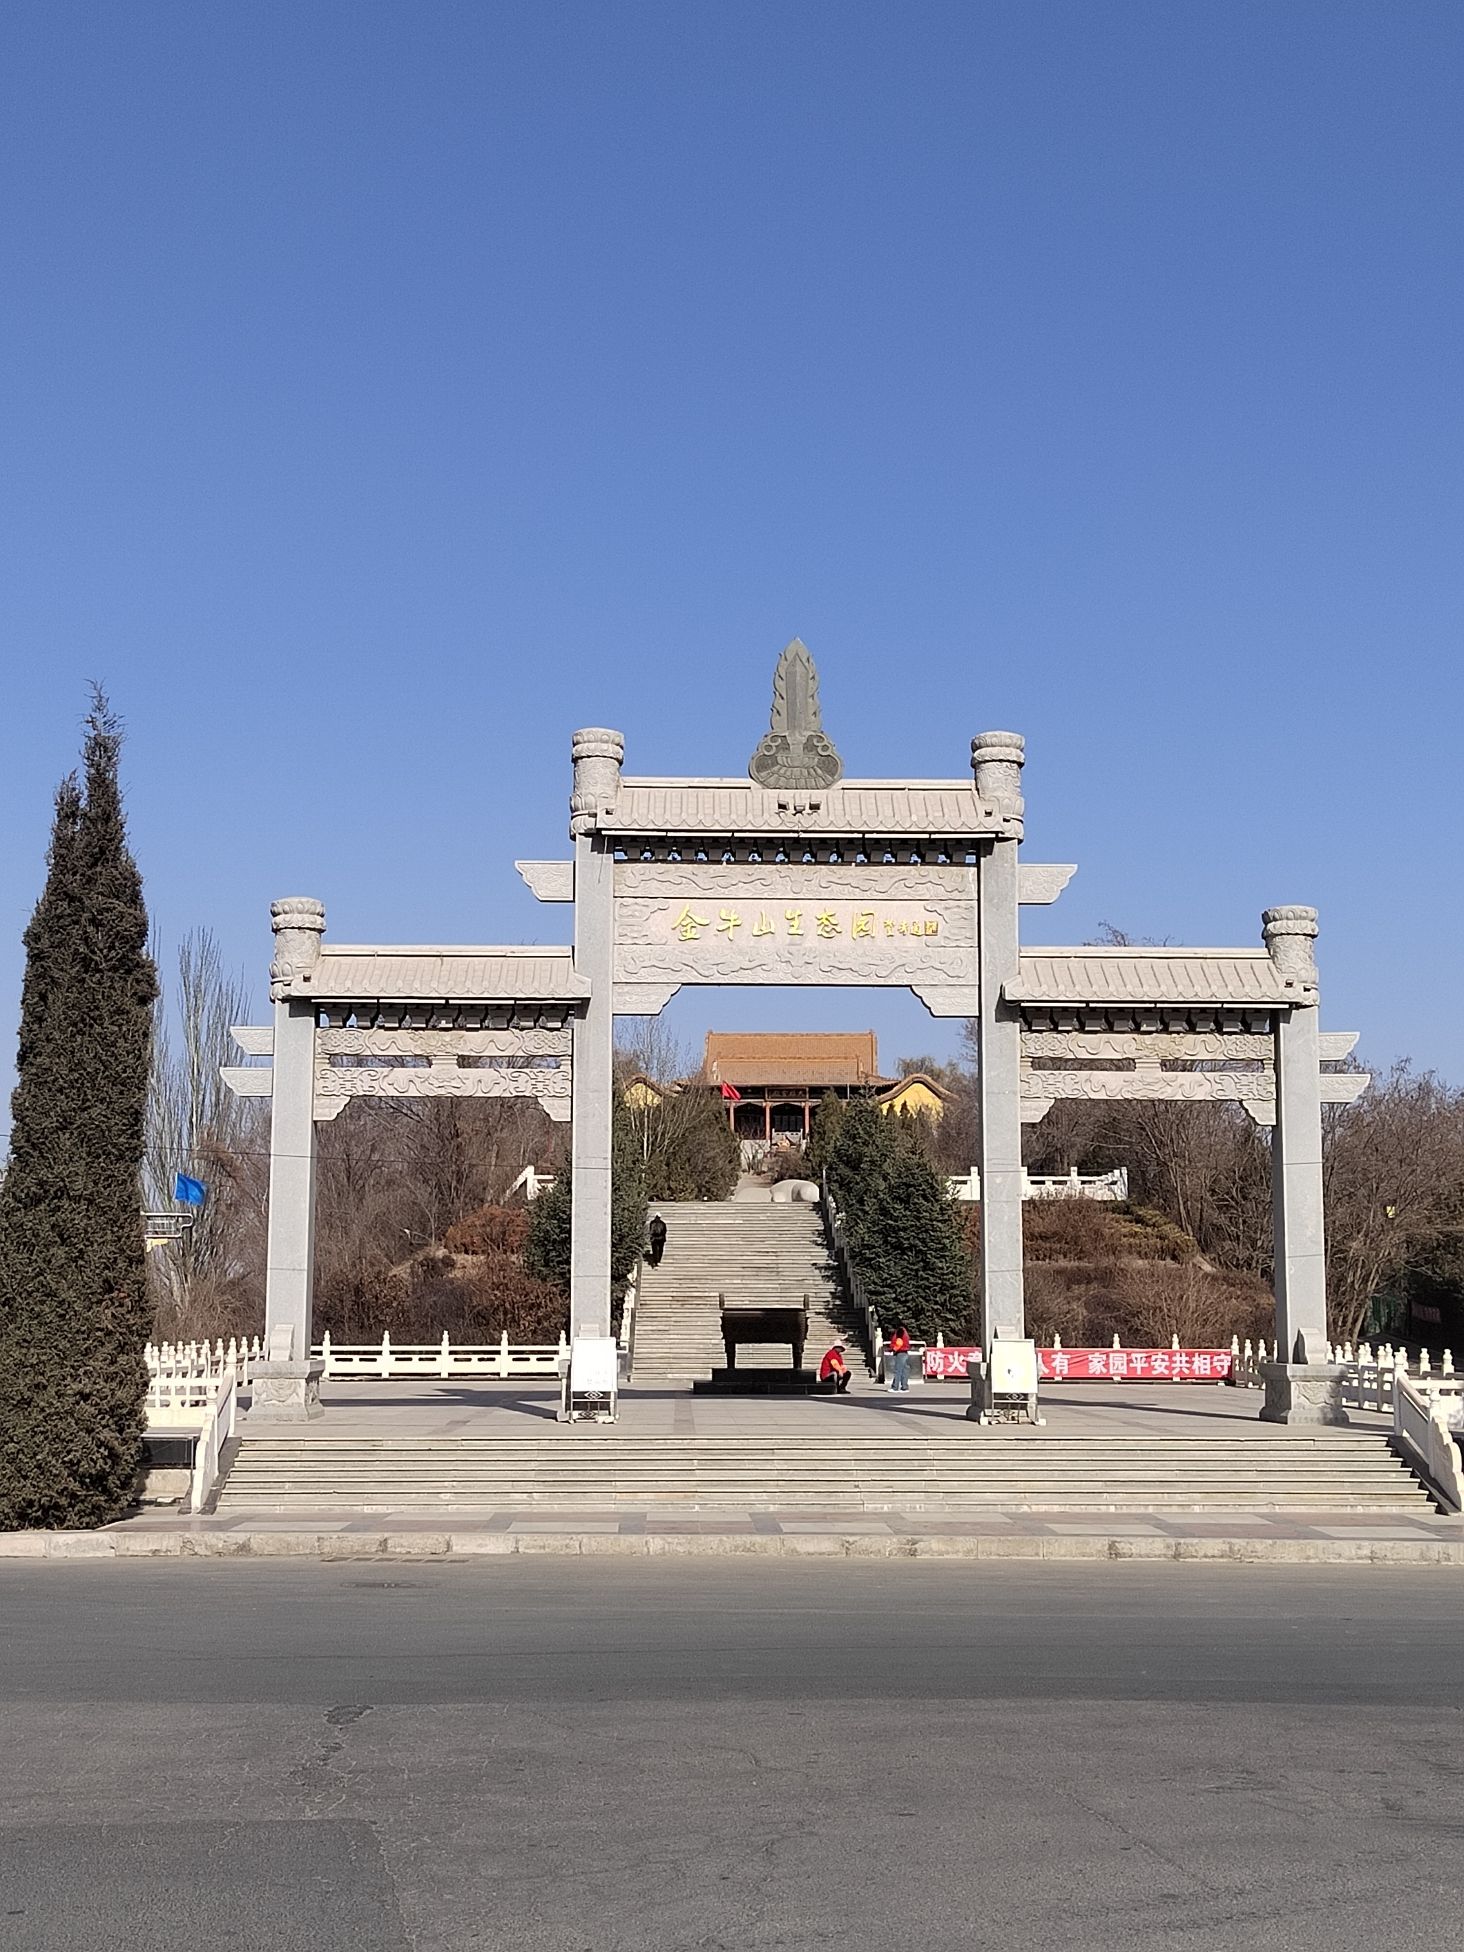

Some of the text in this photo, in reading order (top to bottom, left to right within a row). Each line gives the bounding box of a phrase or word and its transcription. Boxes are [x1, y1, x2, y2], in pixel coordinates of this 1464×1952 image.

[672, 903, 876, 941] 金牛山生态园
[1089, 1353, 1231, 1375] 家园平安共相守
